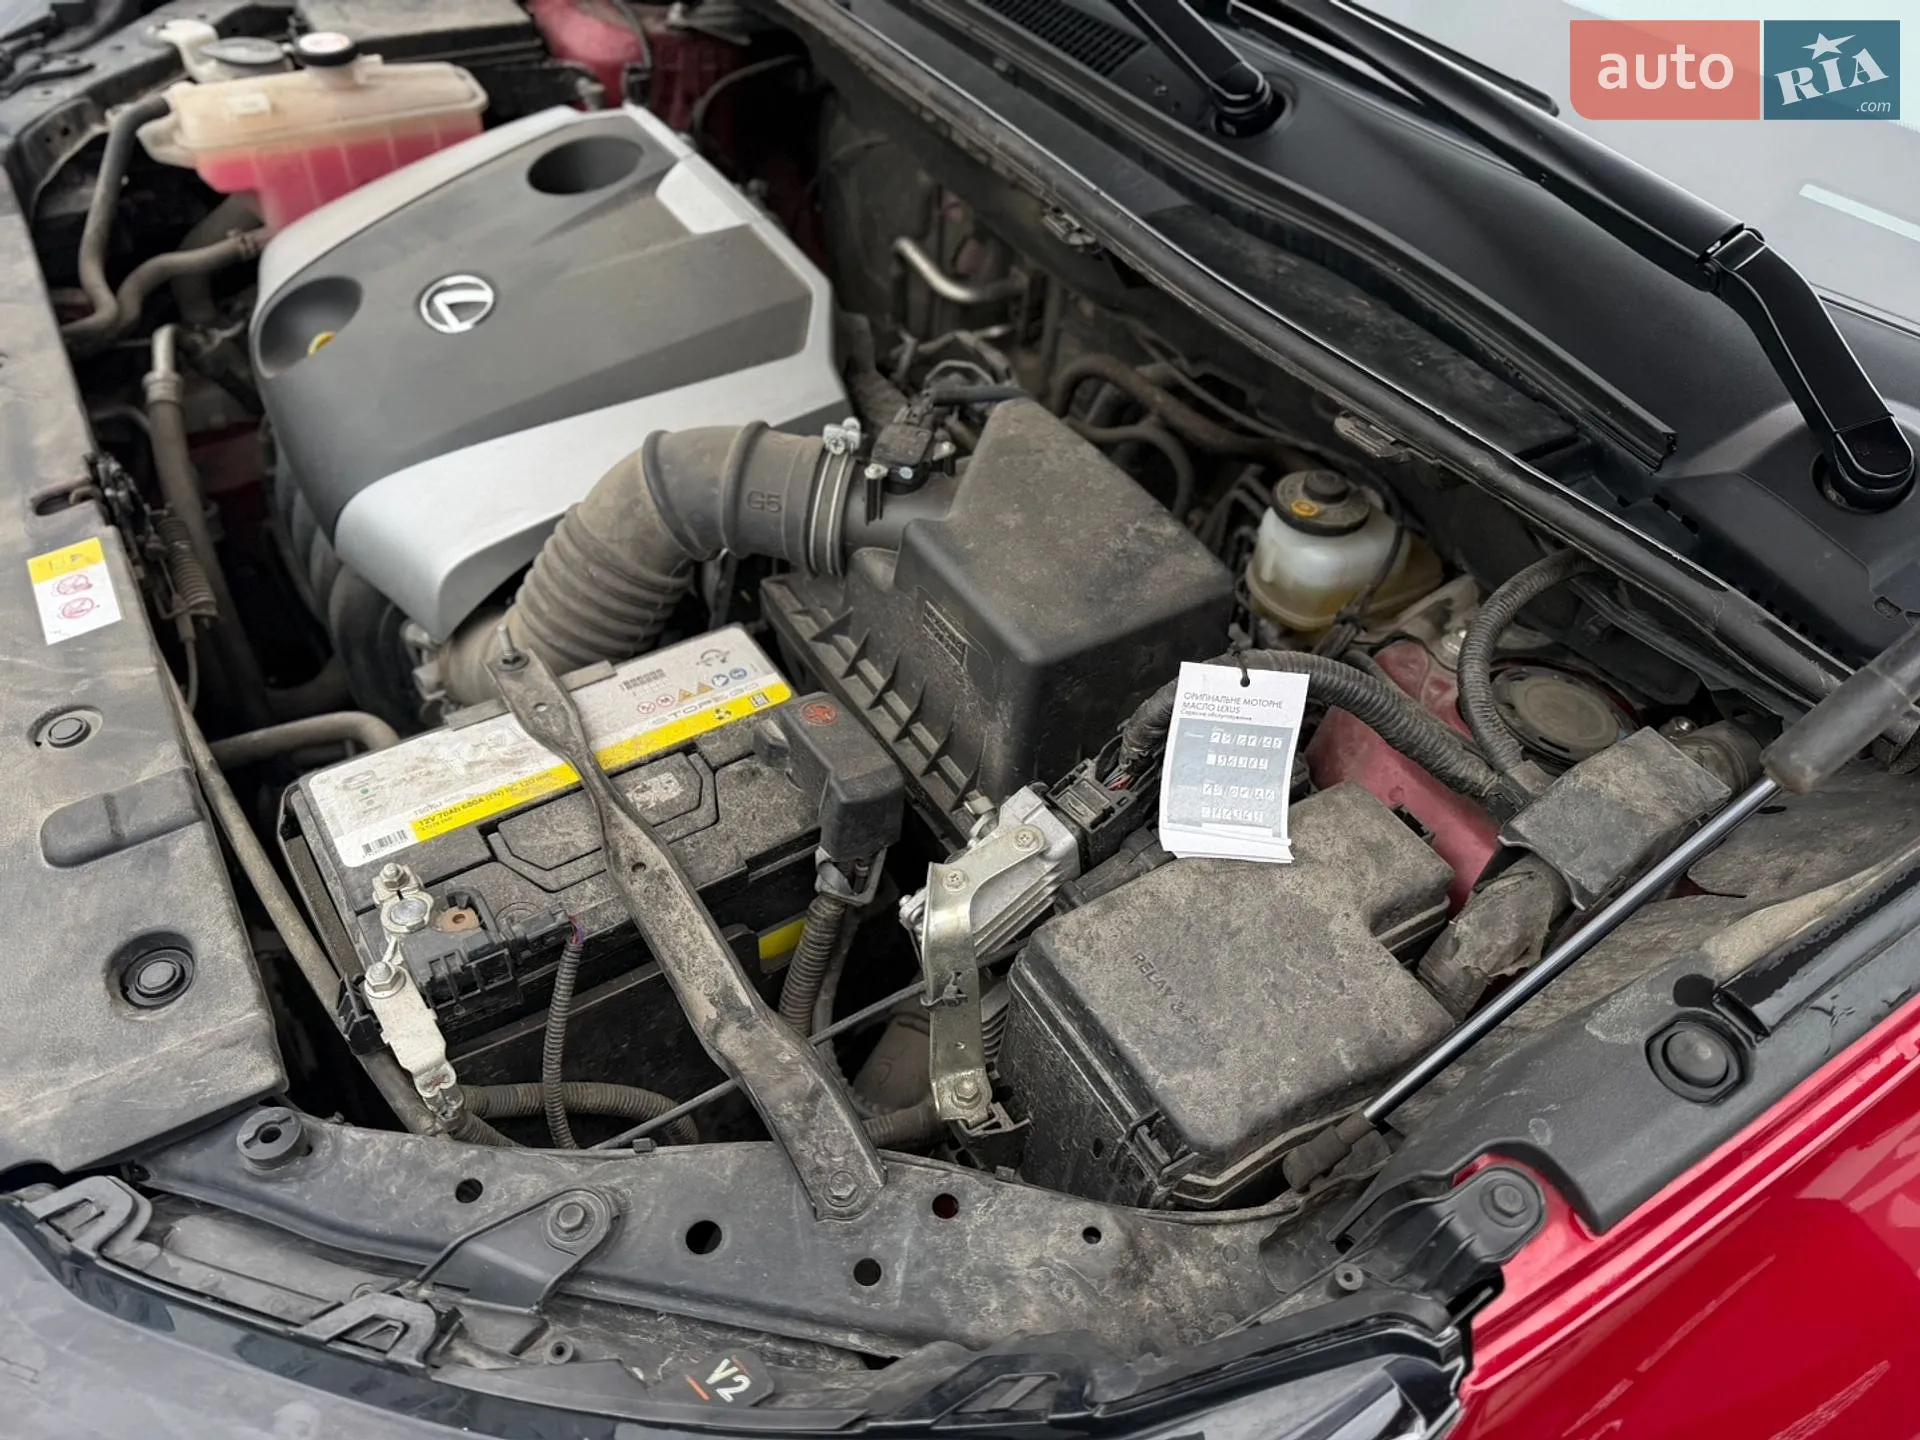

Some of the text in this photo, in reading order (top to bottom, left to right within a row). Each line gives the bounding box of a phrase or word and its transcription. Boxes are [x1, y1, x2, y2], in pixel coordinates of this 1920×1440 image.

[747, 491, 782, 512] G5
[1182, 701, 1241, 714] МАСЛО LEXUS
[1131, 951, 1175, 997] RELAY
[705, 1358, 752, 1403] V2
